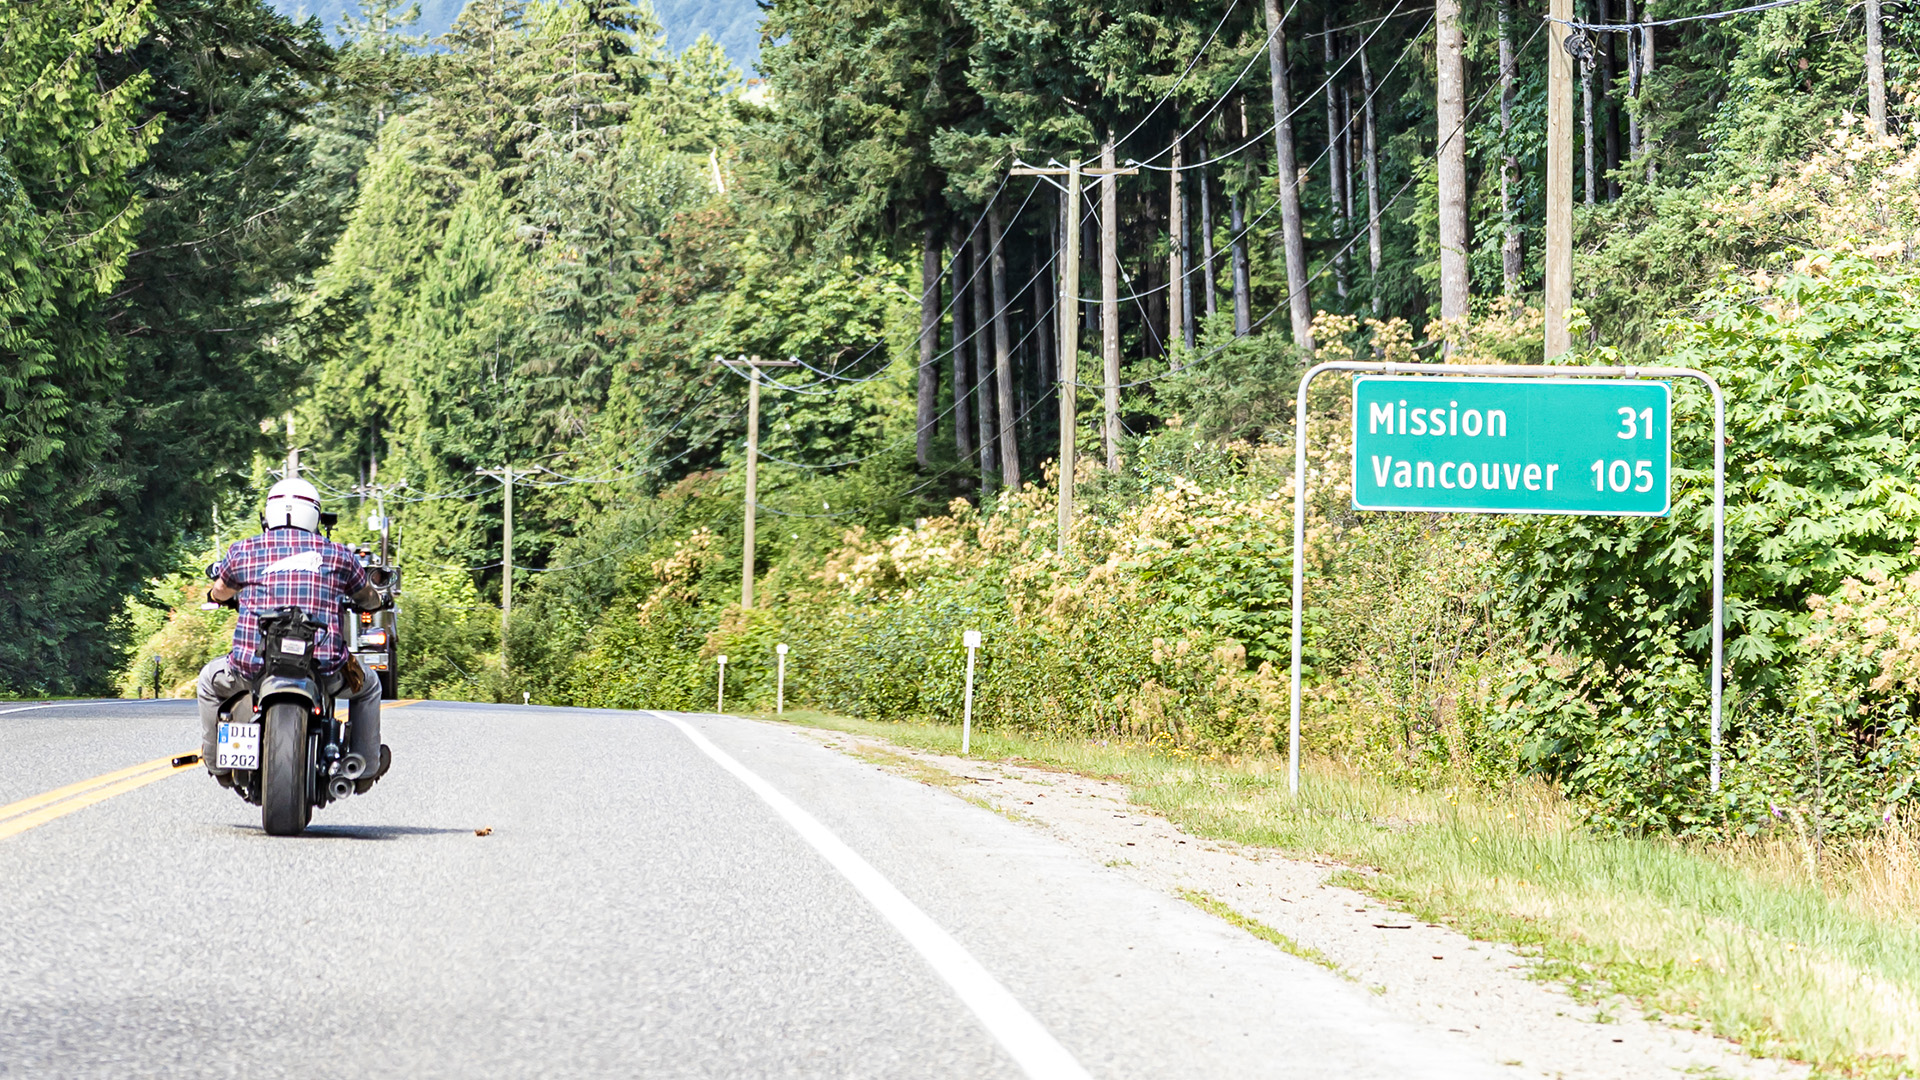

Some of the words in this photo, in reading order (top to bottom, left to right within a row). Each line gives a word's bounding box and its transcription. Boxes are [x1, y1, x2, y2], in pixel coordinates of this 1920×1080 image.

[1369, 399, 1507, 437] Mission
[1616, 406, 1653, 440] 31
[1371, 455, 1559, 491] Vancouver
[1590, 459, 1654, 493] 105
[231, 726, 256, 738] DIL
[219, 754, 227, 766] B
[230, 754, 255, 767] 202
